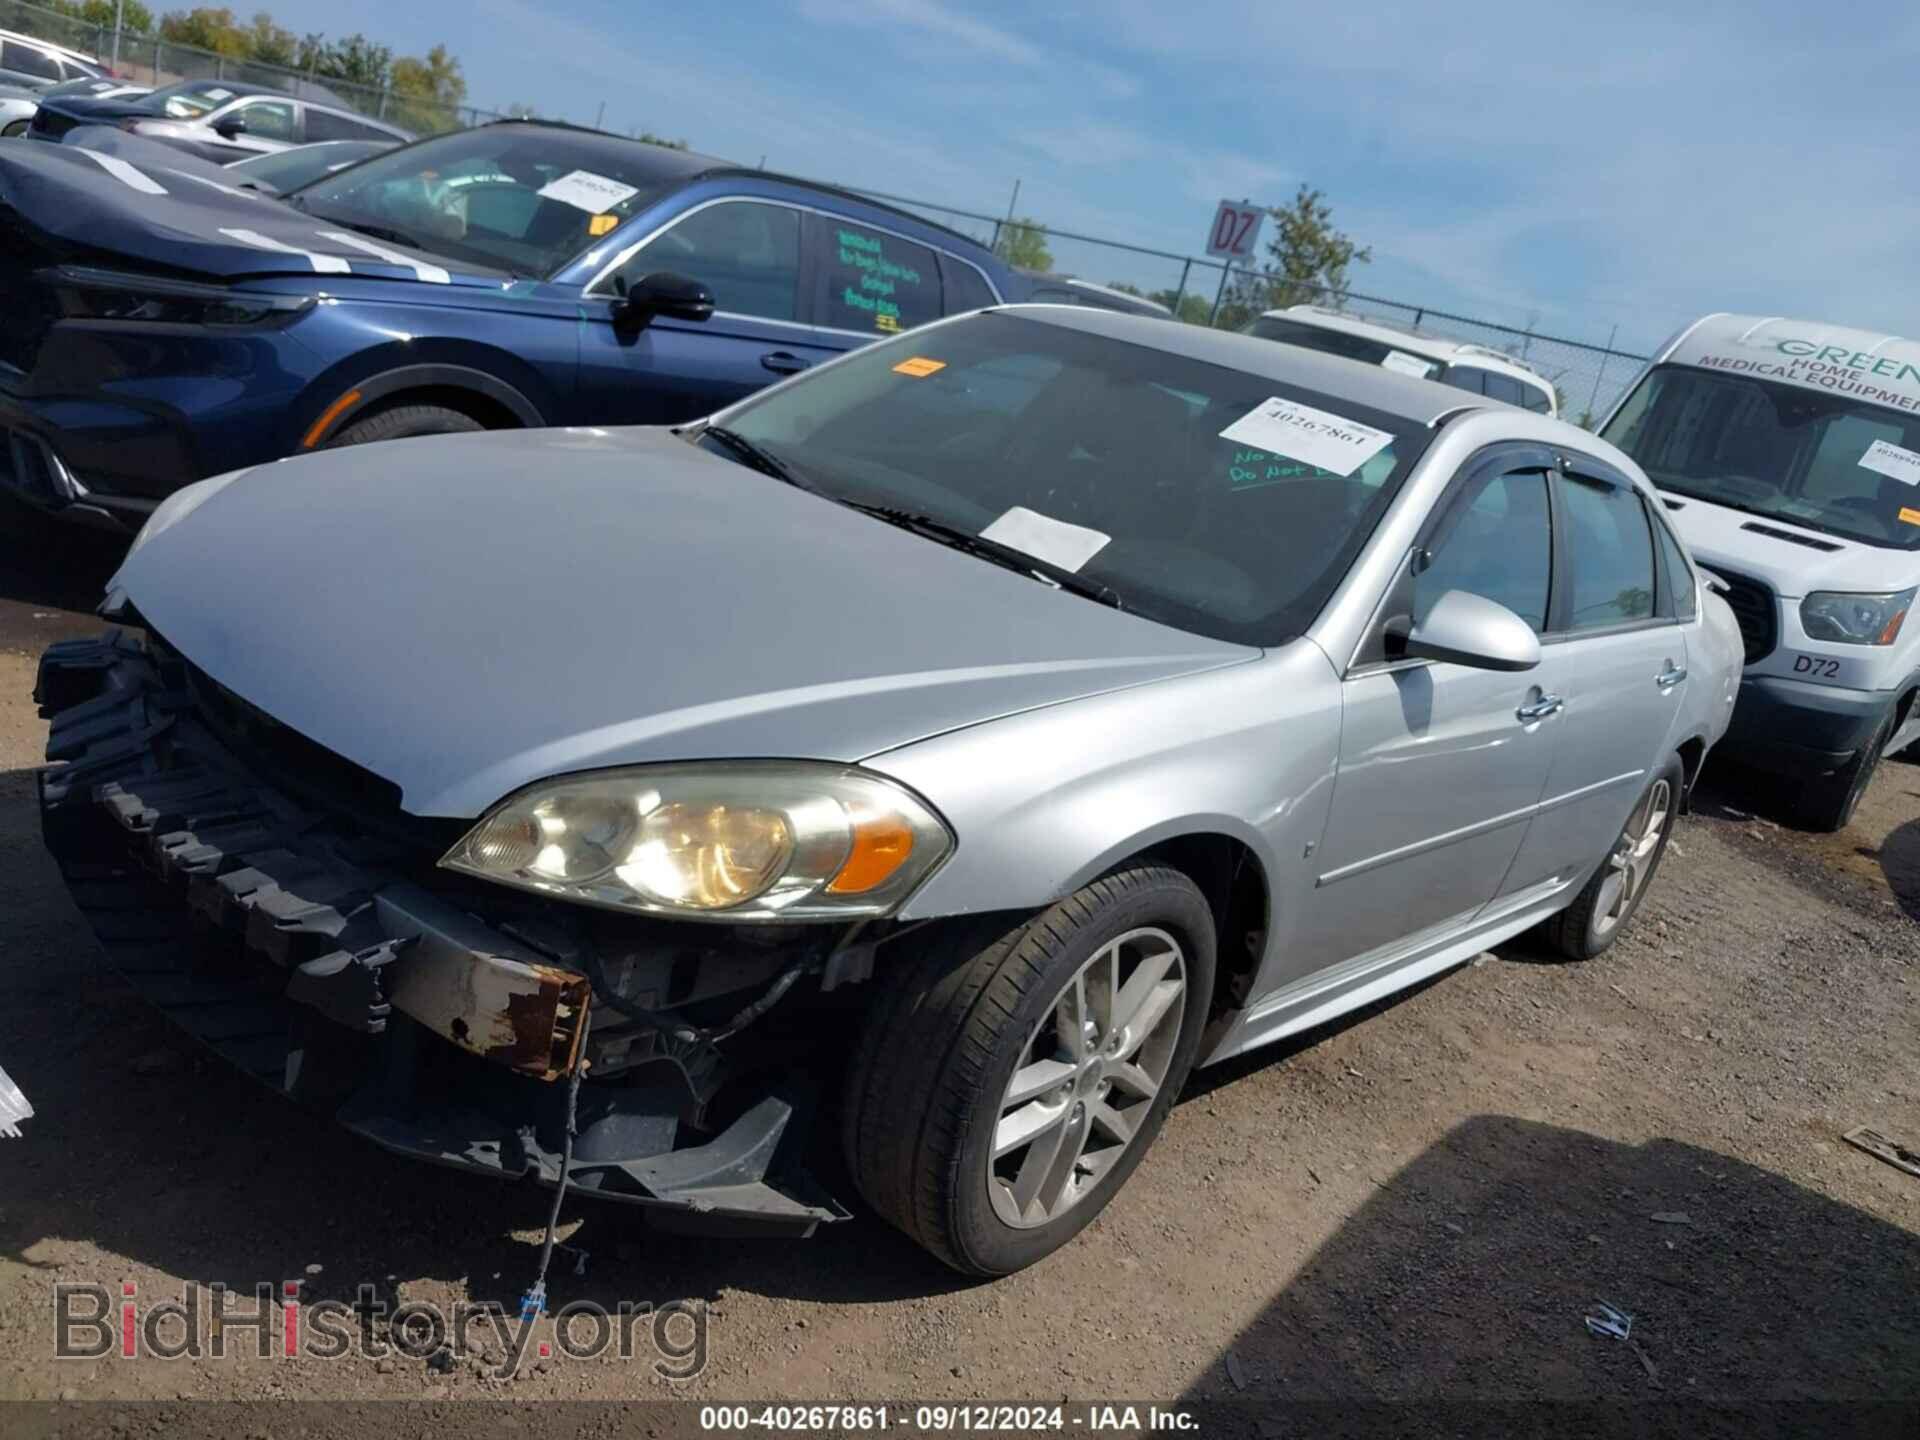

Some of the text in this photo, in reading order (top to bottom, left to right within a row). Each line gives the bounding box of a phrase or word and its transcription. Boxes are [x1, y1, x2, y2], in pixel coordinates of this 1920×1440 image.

[1697, 355, 1799, 380] MEDICAL
[1777, 339, 1920, 384] GREEN
[1791, 358, 1864, 382] HOME
[1266, 408, 1367, 446] 40267861
[1230, 465, 1257, 482] Do
[1265, 463, 1307, 480] Not
[1793, 654, 1841, 679] D72
